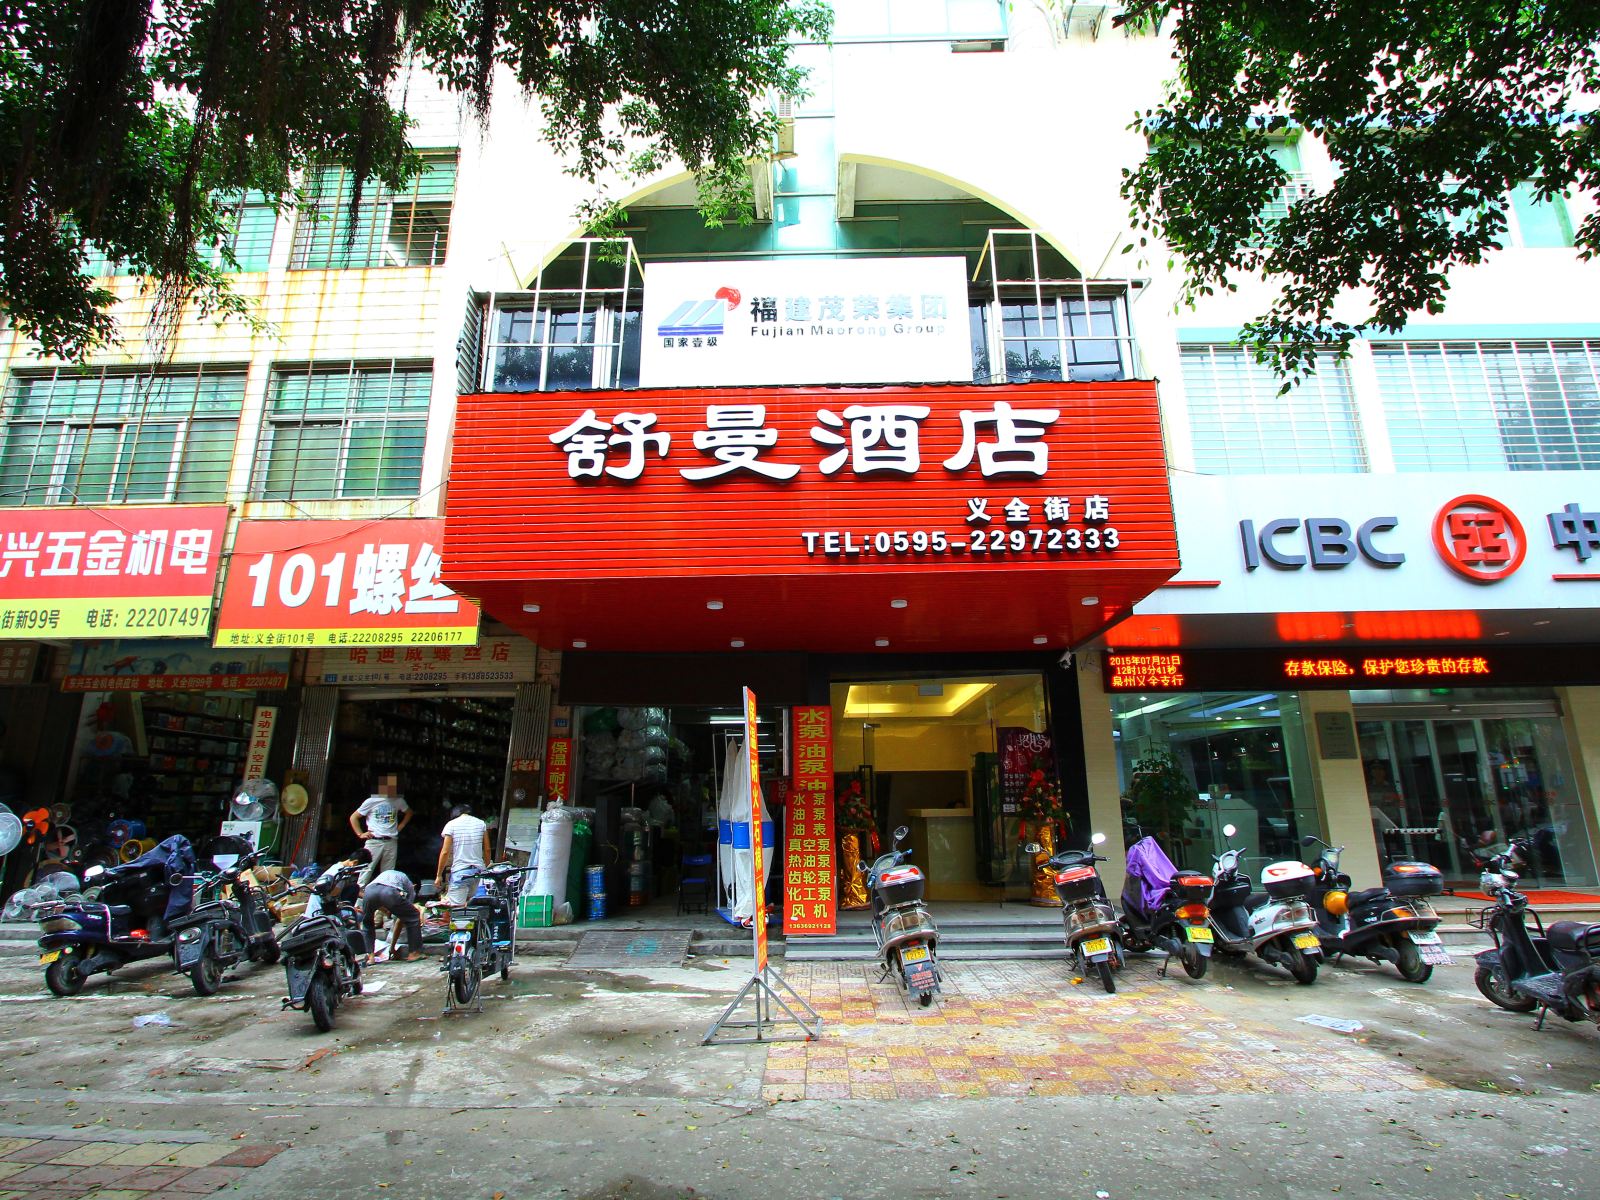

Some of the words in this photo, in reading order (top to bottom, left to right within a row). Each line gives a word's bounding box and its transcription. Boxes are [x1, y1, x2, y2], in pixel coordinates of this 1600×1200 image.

[751, 293, 948, 322] 福建茂荣集团
[751, 325, 805, 339] Fujian
[810, 324, 887, 337] Maorong
[893, 323, 946, 337] Group
[663, 337, 718, 348] 国家壹级
[549, 401, 1061, 481] 舒曼酒店
[966, 494, 1109, 522] 义全街店
[802, 527, 1120, 554] TEL:0595-22972333
[1546, 502, 1600, 561] 中
[1239, 516, 1406, 573] ICBC
[248, 542, 459, 615] 101螺丝
[411, 631, 463, 643] 22206177
[1110, 655, 1181, 666] 2015年07月21日
[1116, 665, 1177, 676] 12时18分41秒
[798, 708, 827, 739] 水泵
[798, 743, 828, 774] 油泵
[789, 838, 831, 852] 真空泵
[788, 853, 831, 868] 热油泵
[788, 870, 831, 885] 齿轮泵
[788, 886, 832, 902] 化工泵
